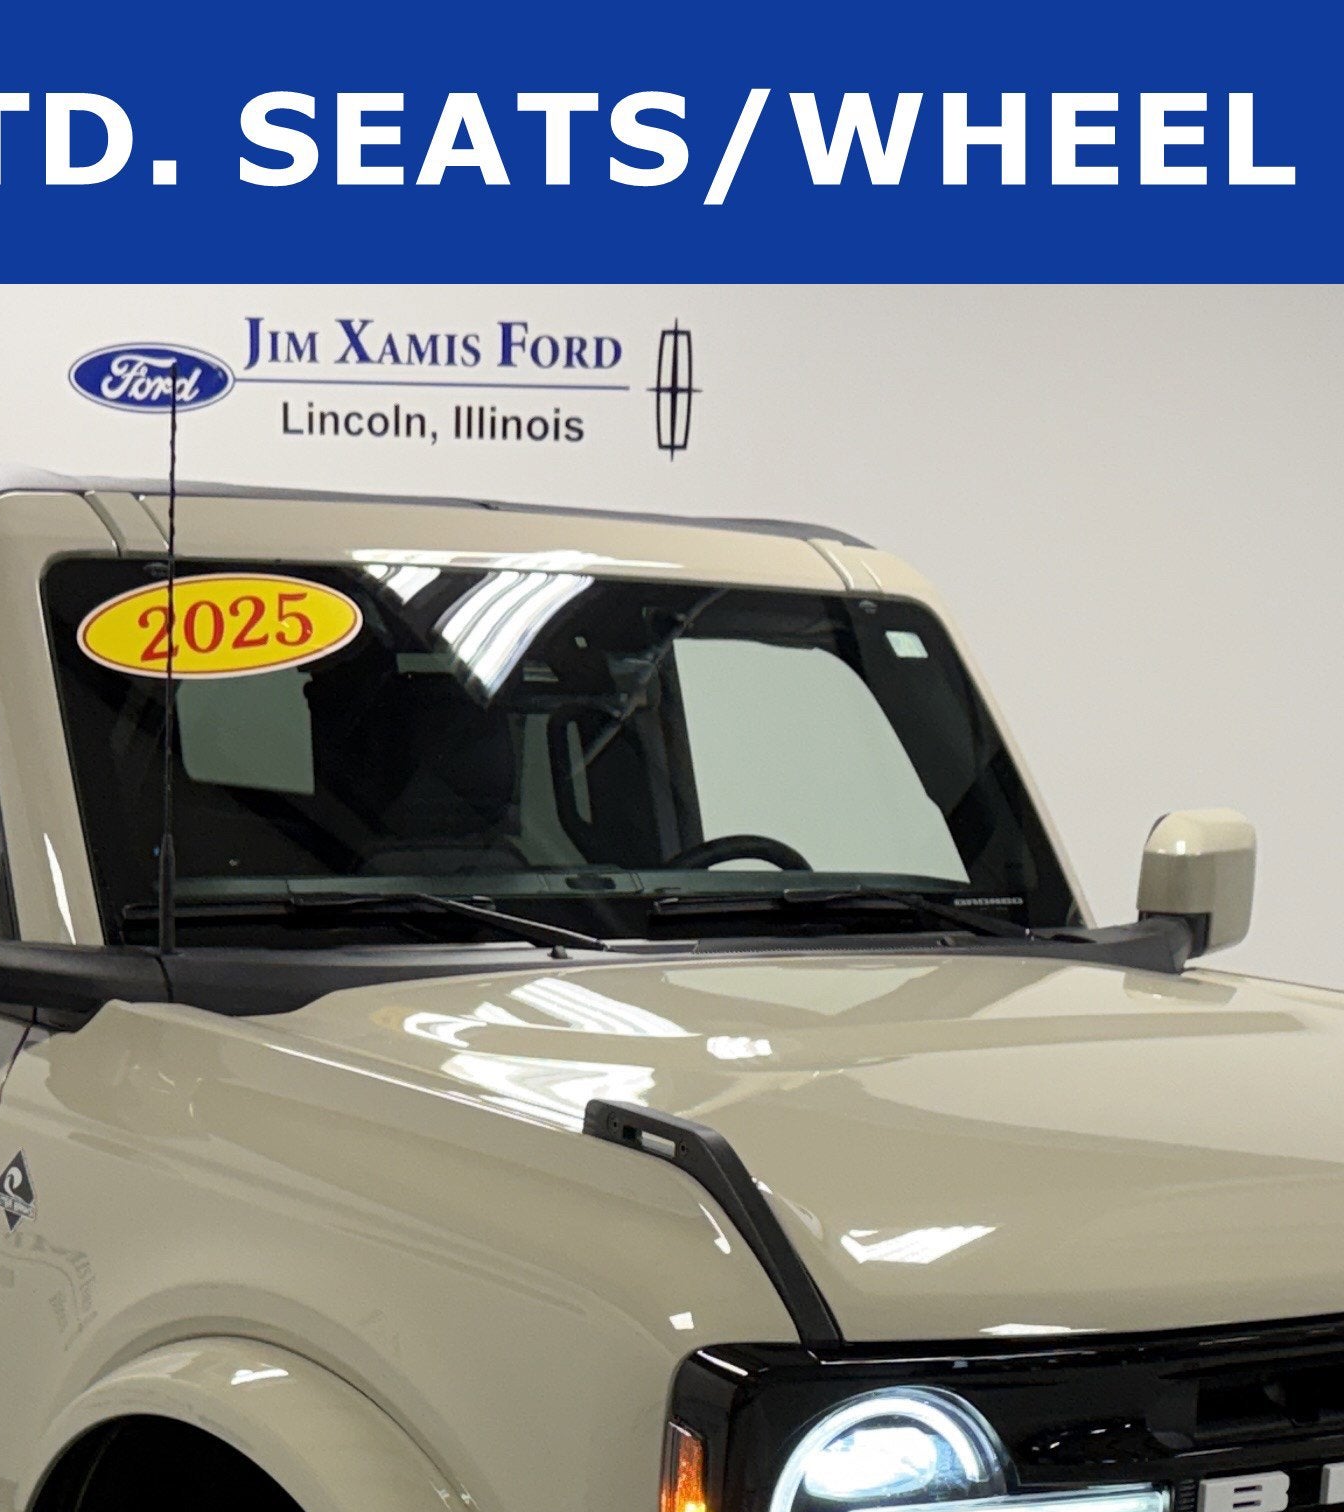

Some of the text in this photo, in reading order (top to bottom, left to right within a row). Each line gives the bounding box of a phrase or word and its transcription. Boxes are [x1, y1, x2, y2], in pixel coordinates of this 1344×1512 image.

[245, 316, 623, 371] JIM XAMIS FORD
[99, 354, 201, 402] Ford
[281, 402, 585, 445] Lincoln, Illinois
[136, 592, 316, 664] 2025
